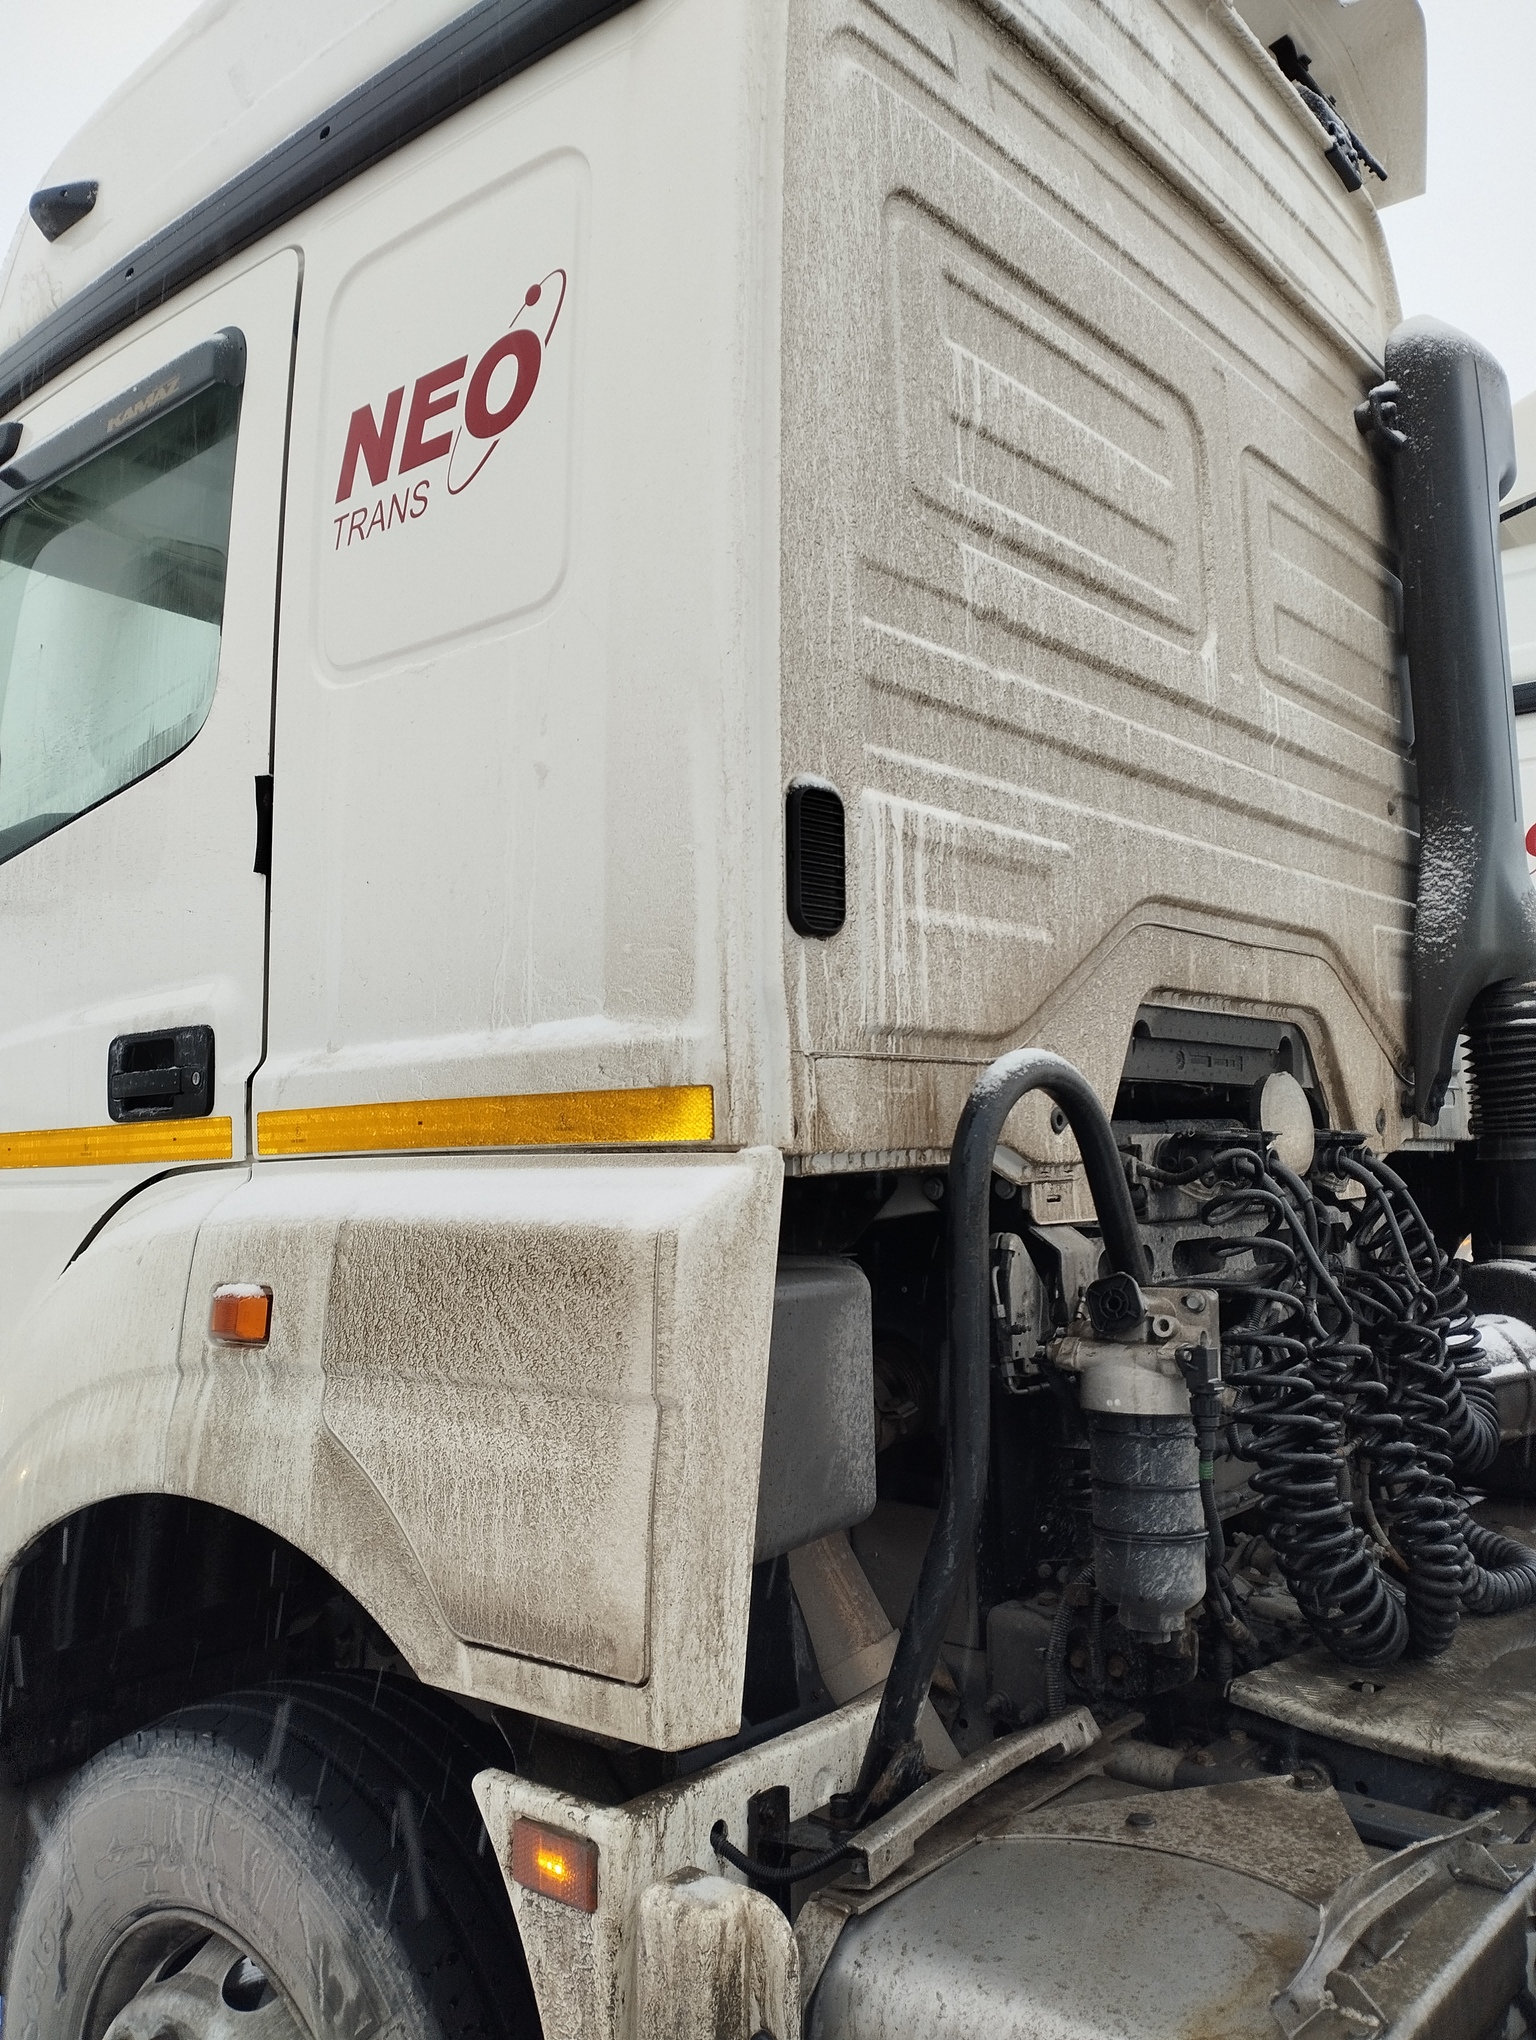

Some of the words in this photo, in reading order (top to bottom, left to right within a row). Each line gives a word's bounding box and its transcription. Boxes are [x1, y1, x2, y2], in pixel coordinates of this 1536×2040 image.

[107, 374, 180, 432] KAMAZ
[335, 329, 541, 504] NEO
[334, 480, 430, 550] TRANS
